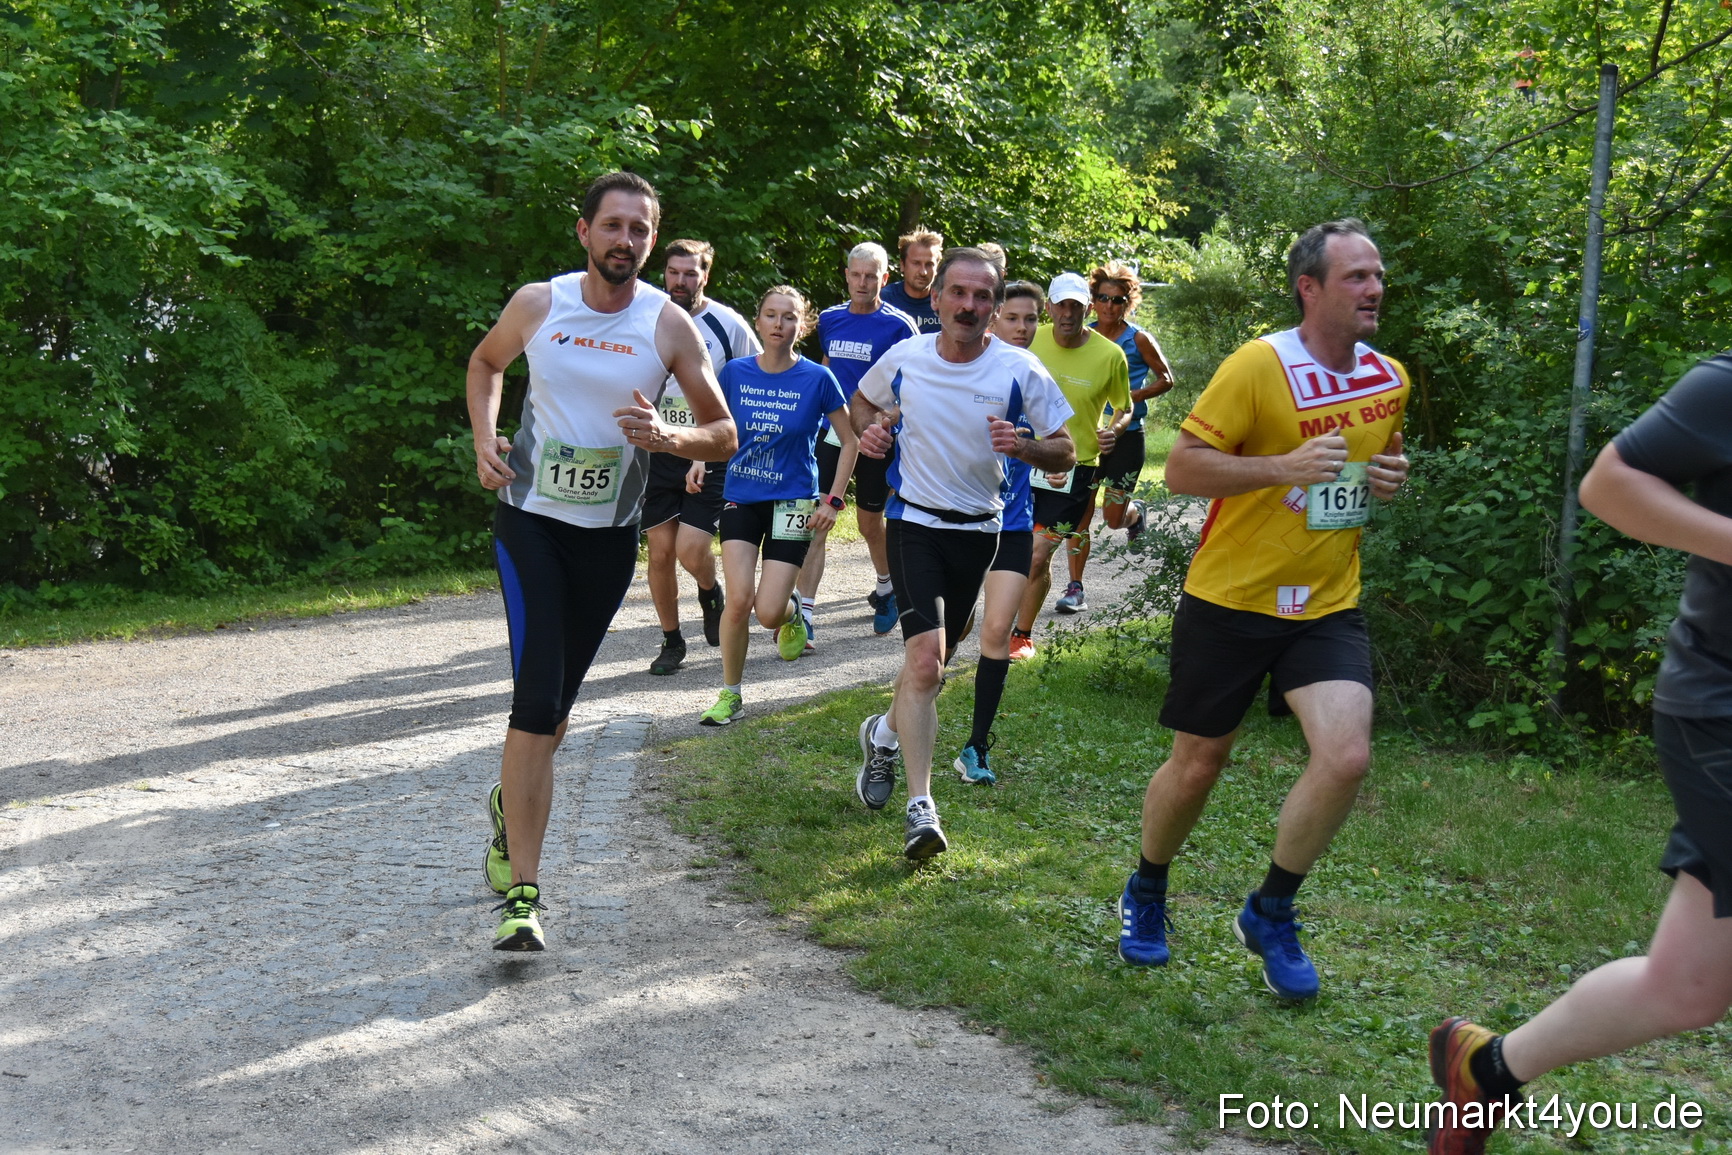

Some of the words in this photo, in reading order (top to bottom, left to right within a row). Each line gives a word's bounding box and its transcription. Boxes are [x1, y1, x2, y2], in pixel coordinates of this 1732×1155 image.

[574, 336, 638, 356] KLEBL
[829, 339, 873, 356] HUBER
[835, 352, 869, 361] TECHNOLOGY
[739, 384, 765, 396] Wenn
[767, 389, 776, 397] es
[778, 388, 801, 400] beim
[740, 396, 797, 411] Hausverkauf
[662, 408, 695, 425] 1881
[752, 411, 780, 422] richtig
[1299, 411, 1355, 438] MAX
[745, 421, 783, 433] LAUFEN
[753, 434, 770, 443] soll!
[550, 463, 611, 490] 1155
[729, 462, 783, 481] FELDBUSCH
[730, 471, 778, 485] IMMOBILIEN
[558, 486, 581, 495] Görner
[1319, 485, 1370, 510] 1612
